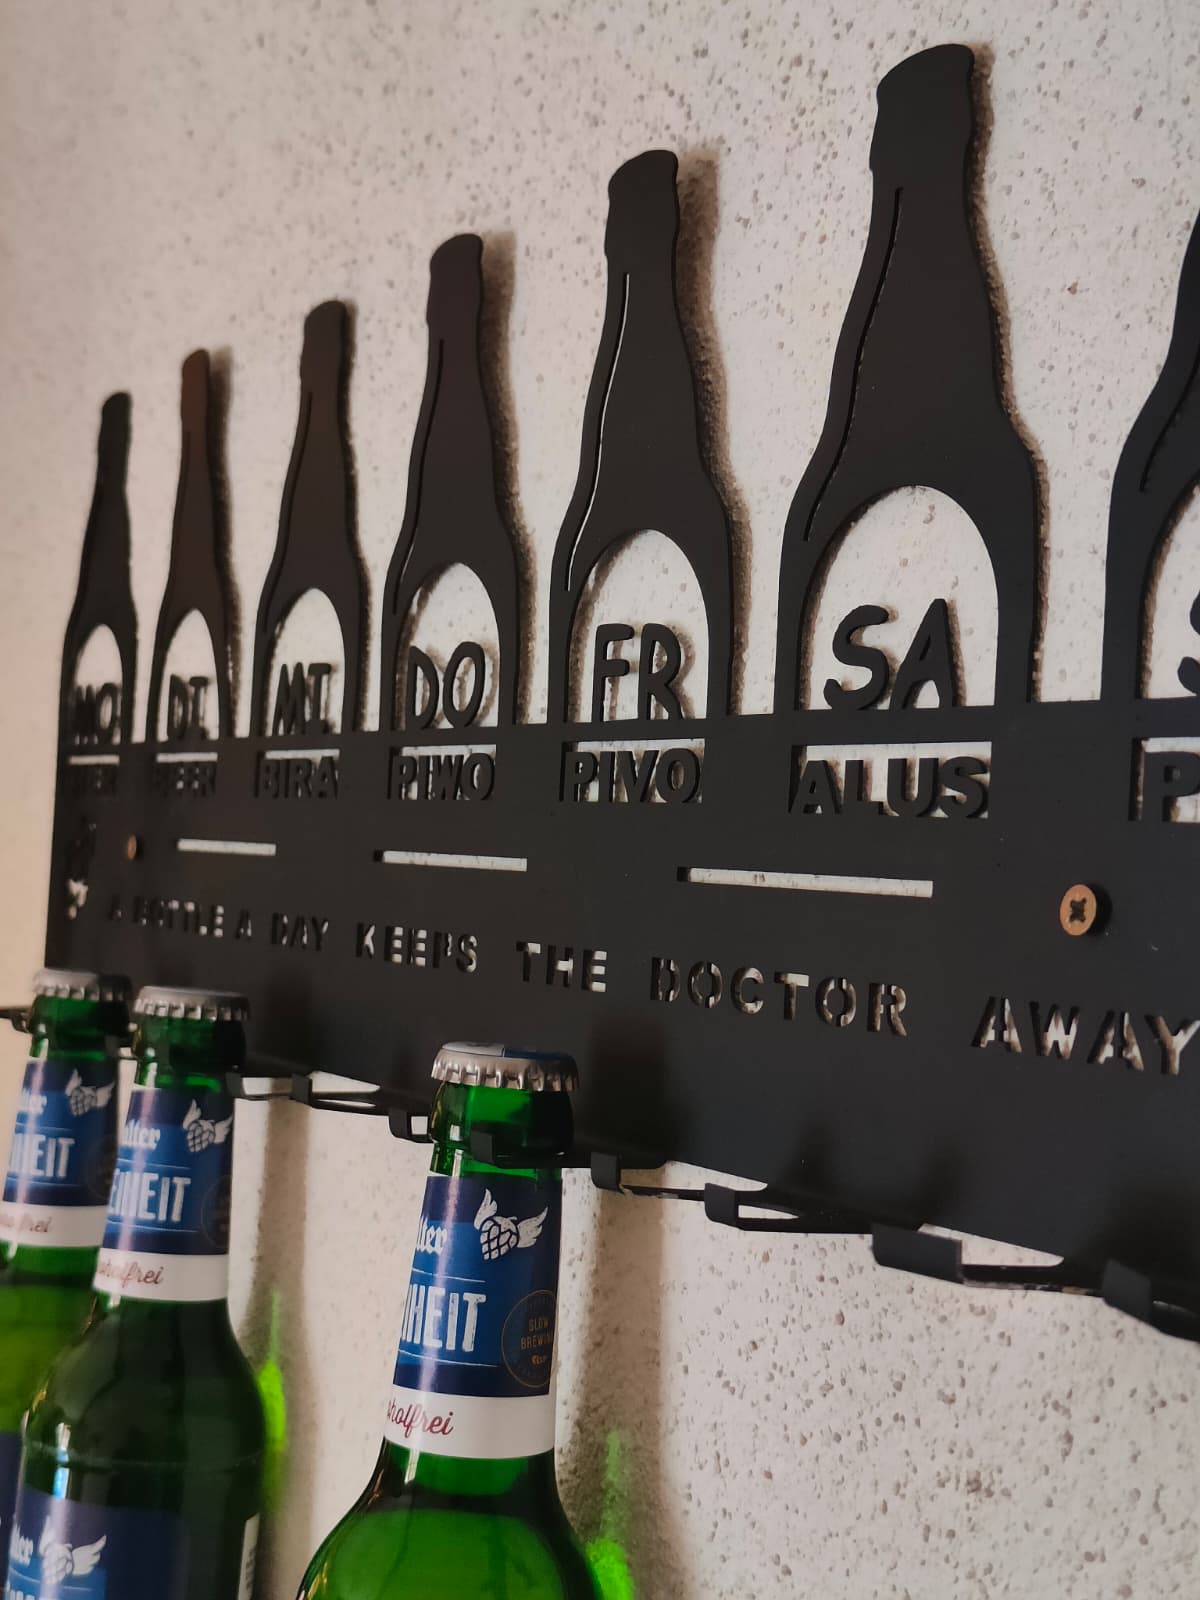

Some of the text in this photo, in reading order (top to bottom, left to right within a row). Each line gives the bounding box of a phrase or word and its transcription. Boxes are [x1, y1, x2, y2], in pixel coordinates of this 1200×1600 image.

[405, 641, 486, 728] DO
[592, 623, 683, 721] FR
[822, 598, 957, 710] SA
[260, 757, 339, 799] BIRA
[392, 751, 496, 801] PIWO
[564, 748, 700, 802] PIVO
[791, 756, 990, 819] ALUS
[272, 911, 330, 952] DAY
[356, 921, 479, 974] KEEPS
[516, 941, 608, 993] THE
[650, 956, 908, 1037] DOCTOR
[971, 996, 1200, 1076] AWAY
